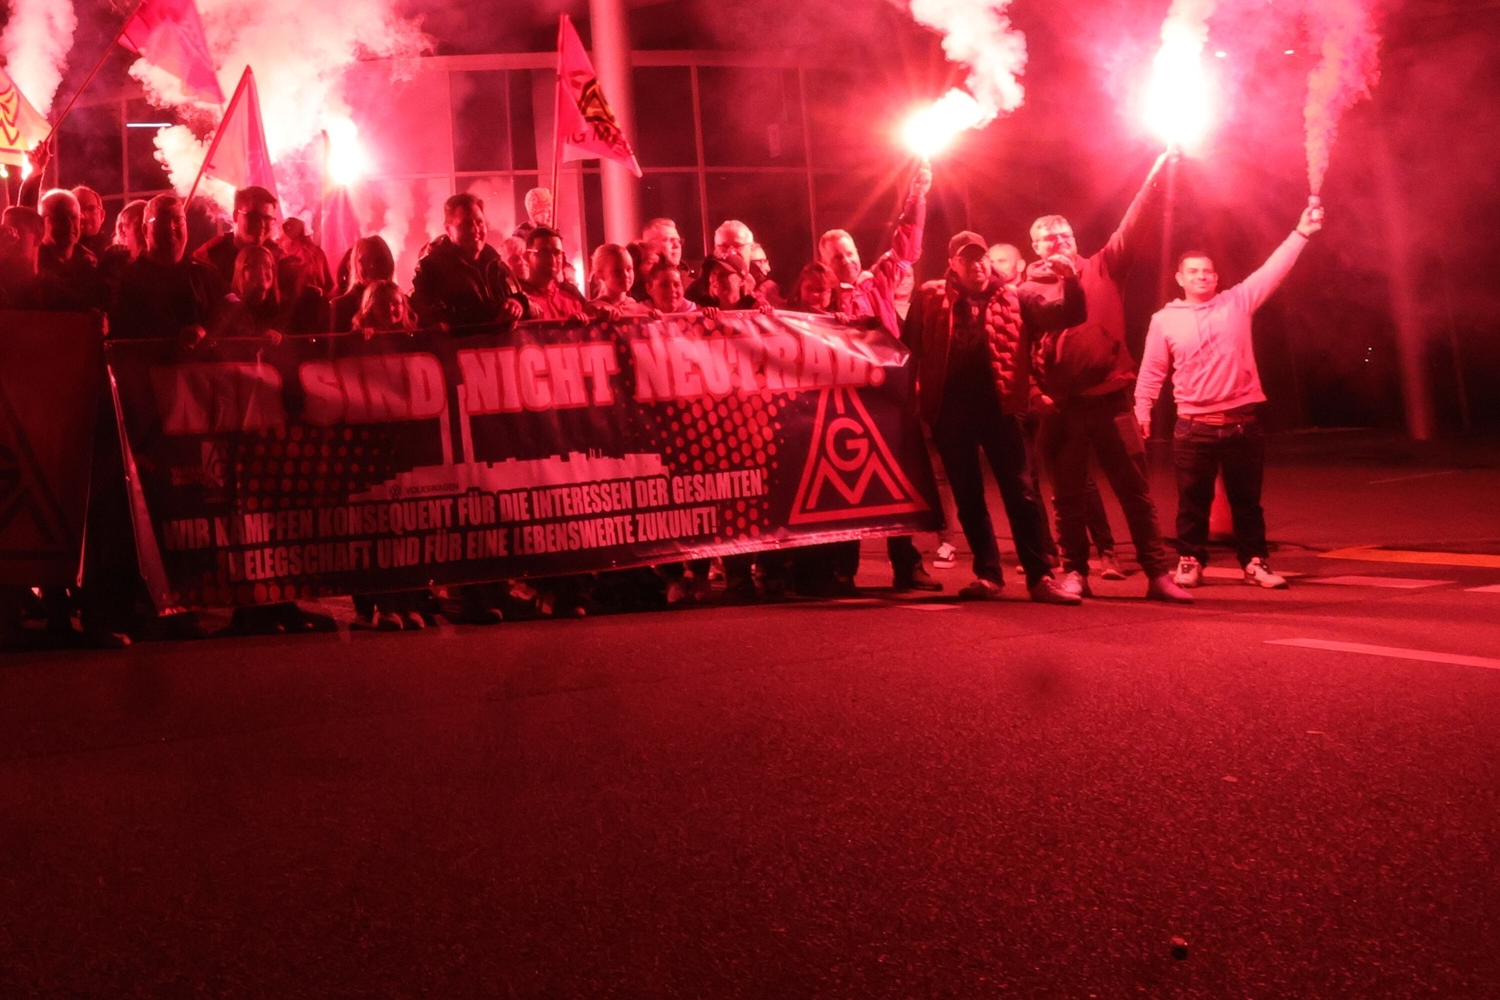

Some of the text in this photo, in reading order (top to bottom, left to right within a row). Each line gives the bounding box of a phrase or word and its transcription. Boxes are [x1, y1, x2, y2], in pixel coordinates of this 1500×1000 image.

[299, 353, 447, 425] SIND
[458, 343, 618, 413] NICHT
[318, 498, 454, 540] KONSEQUENT
[457, 485, 497, 528] FÜR
[500, 489, 531, 520] DIE
[533, 484, 634, 520] INTERESSEN
[636, 478, 670, 508] DER
[672, 468, 764, 506] GESAMTEN
[377, 537, 421, 571] UND
[424, 527, 463, 567] FÜR
[467, 529, 510, 560] EINE
[513, 512, 635, 557] LEBENSWERTE
[637, 505, 718, 543] ZUKUNFT!
